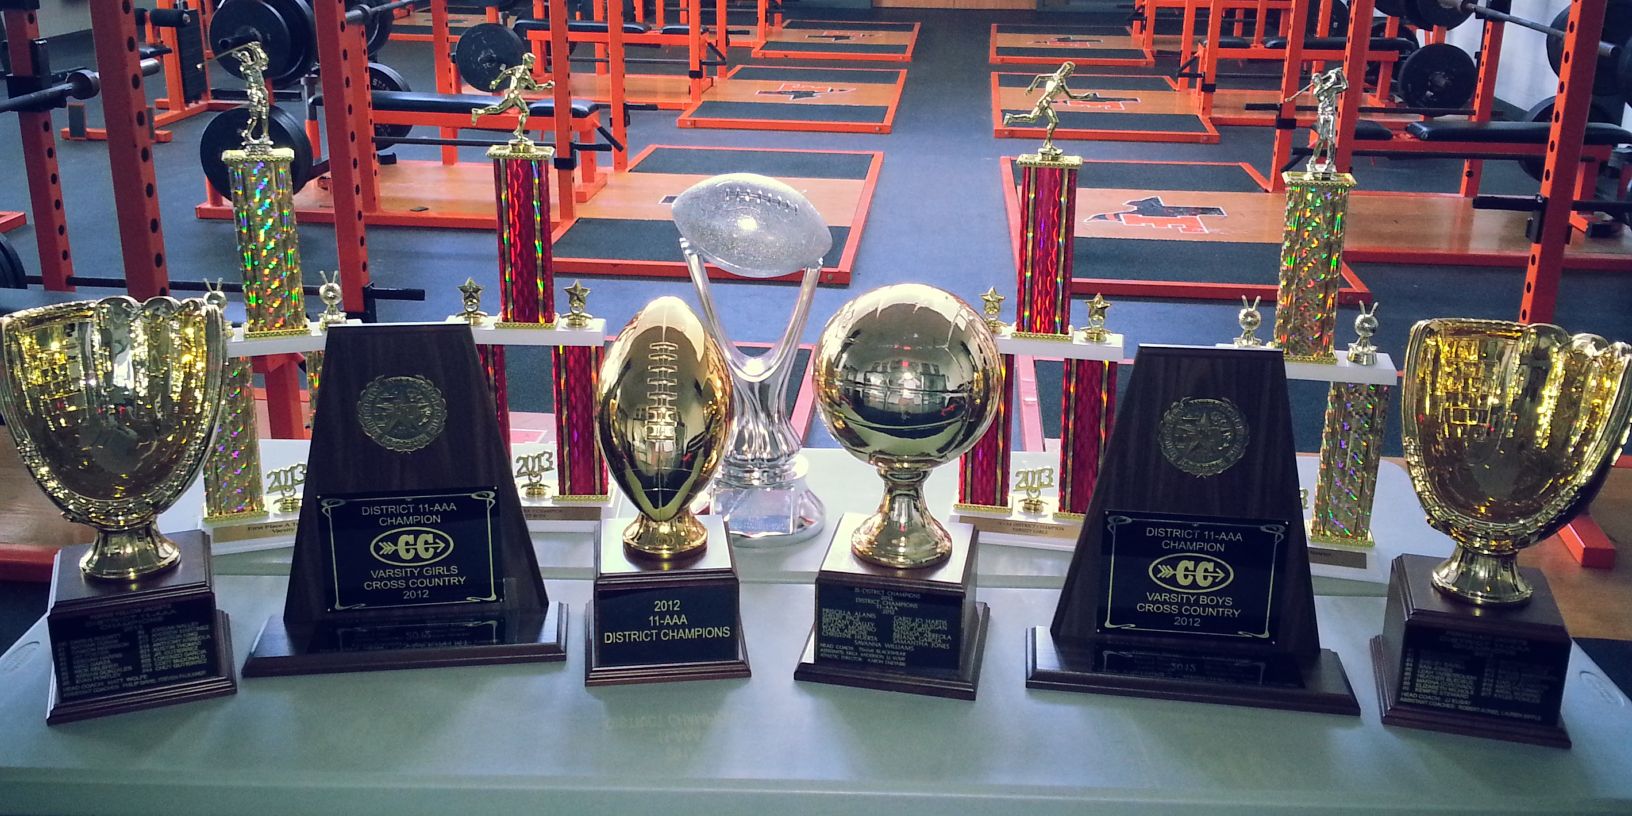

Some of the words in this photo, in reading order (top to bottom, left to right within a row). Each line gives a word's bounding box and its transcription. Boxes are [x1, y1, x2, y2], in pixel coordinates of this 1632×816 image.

[515, 451, 554, 478] 2013
[266, 463, 307, 494] 2013
[1013, 468, 1054, 491] 2013
[361, 504, 415, 517] DISTRICT
[419, 502, 457, 513] 11-AAA
[378, 514, 441, 526] CHAMPION
[1146, 527, 1201, 540] DISTRICT
[1203, 530, 1243, 542] 11-AAA
[397, 533, 435, 560] CC
[1161, 540, 1225, 552] CHAMPION
[370, 568, 420, 579] VARSITY
[423, 566, 458, 576] GIRLS
[1175, 559, 1215, 587] CC
[363, 580, 406, 591] CROSS
[408, 577, 466, 588] COUNTRY
[403, 589, 430, 600] 2012
[1146, 592, 1197, 604] VARSITY
[1199, 595, 1233, 606] BOYS
[654, 599, 681, 612] 2012
[1136, 603, 1178, 615] CROSS
[1181, 605, 1241, 618] COUNTRY
[648, 614, 688, 627] 11-AAA
[1173, 616, 1201, 627] 2012
[604, 629, 658, 644] DISTRICT
[660, 626, 731, 641] CHAMPIONS
